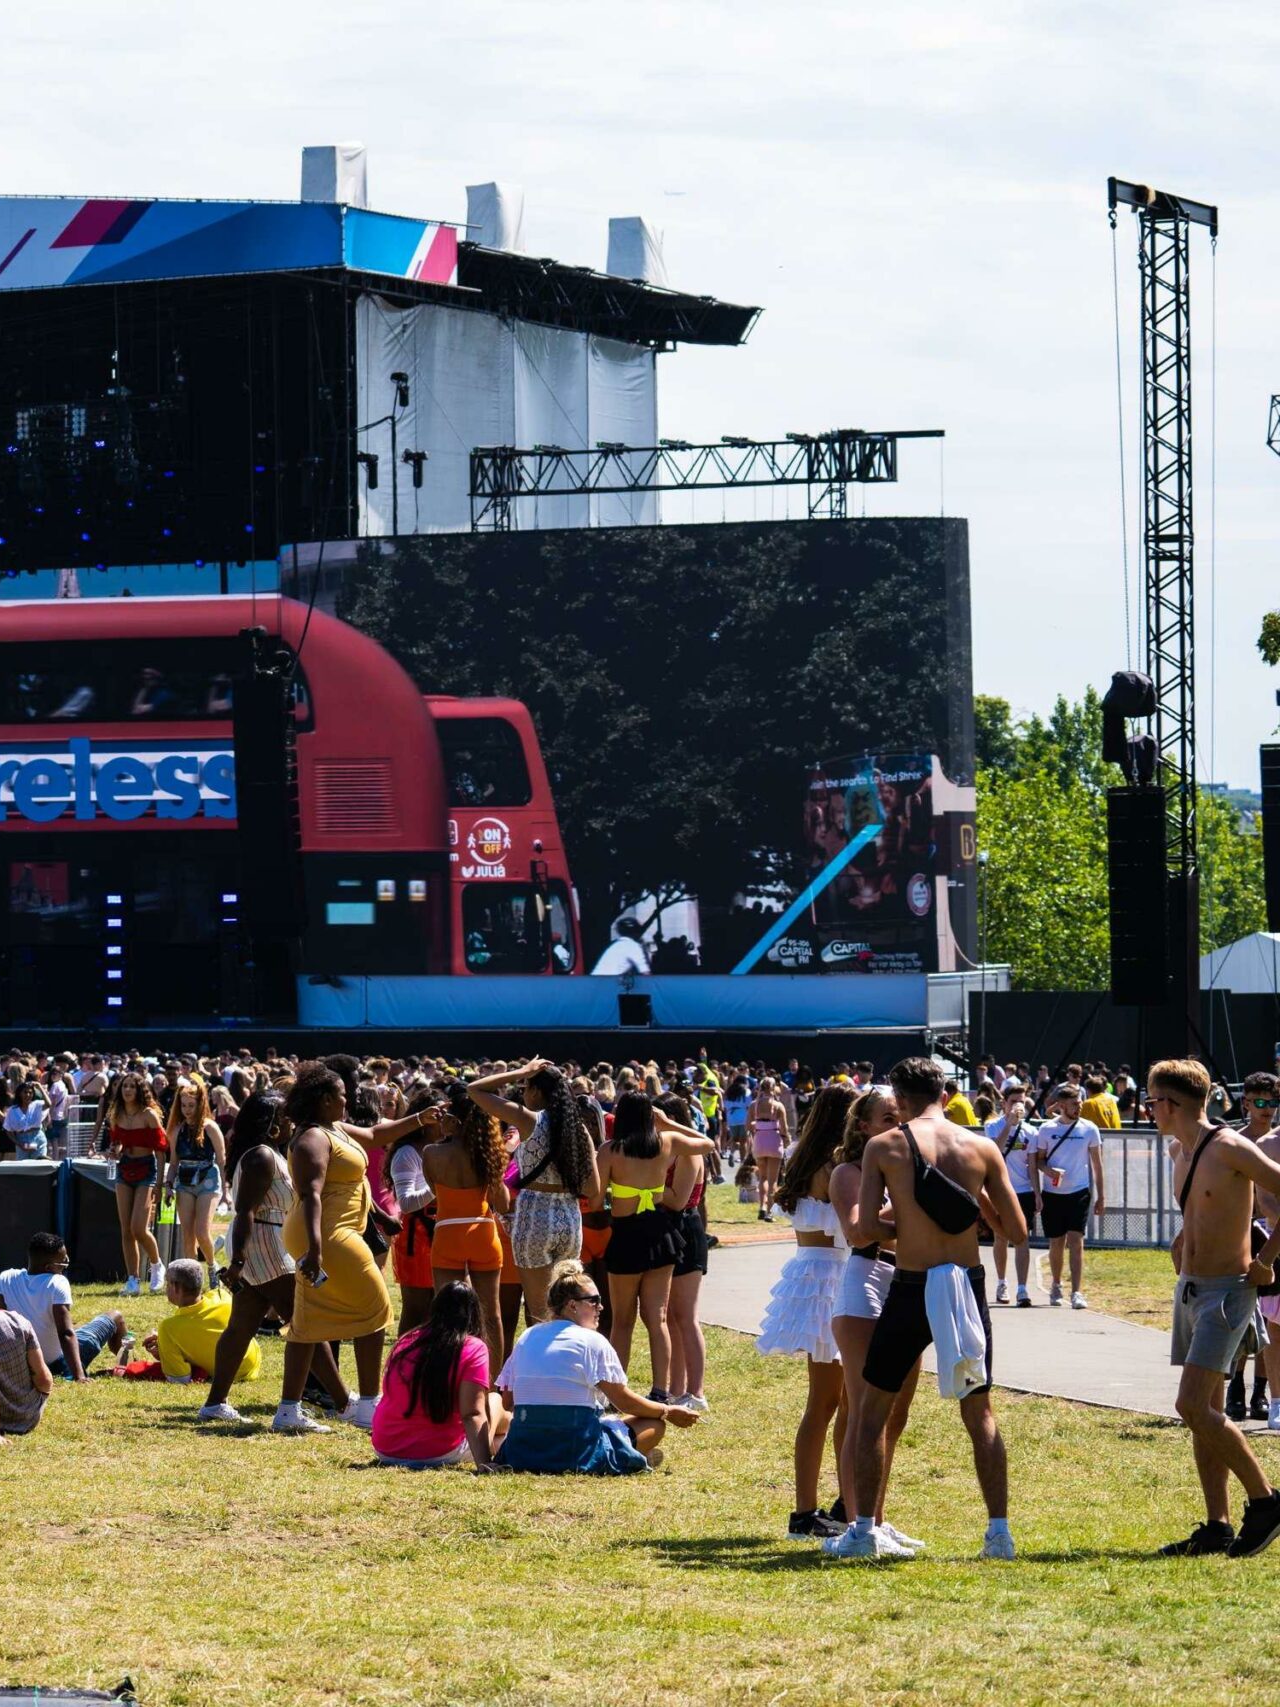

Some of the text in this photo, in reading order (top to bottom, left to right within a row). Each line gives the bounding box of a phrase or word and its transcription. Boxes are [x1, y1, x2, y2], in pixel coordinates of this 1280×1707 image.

[484, 828, 501, 841] ON
[483, 844, 501, 854] OFF
[780, 946, 813, 956] CAPITAL
